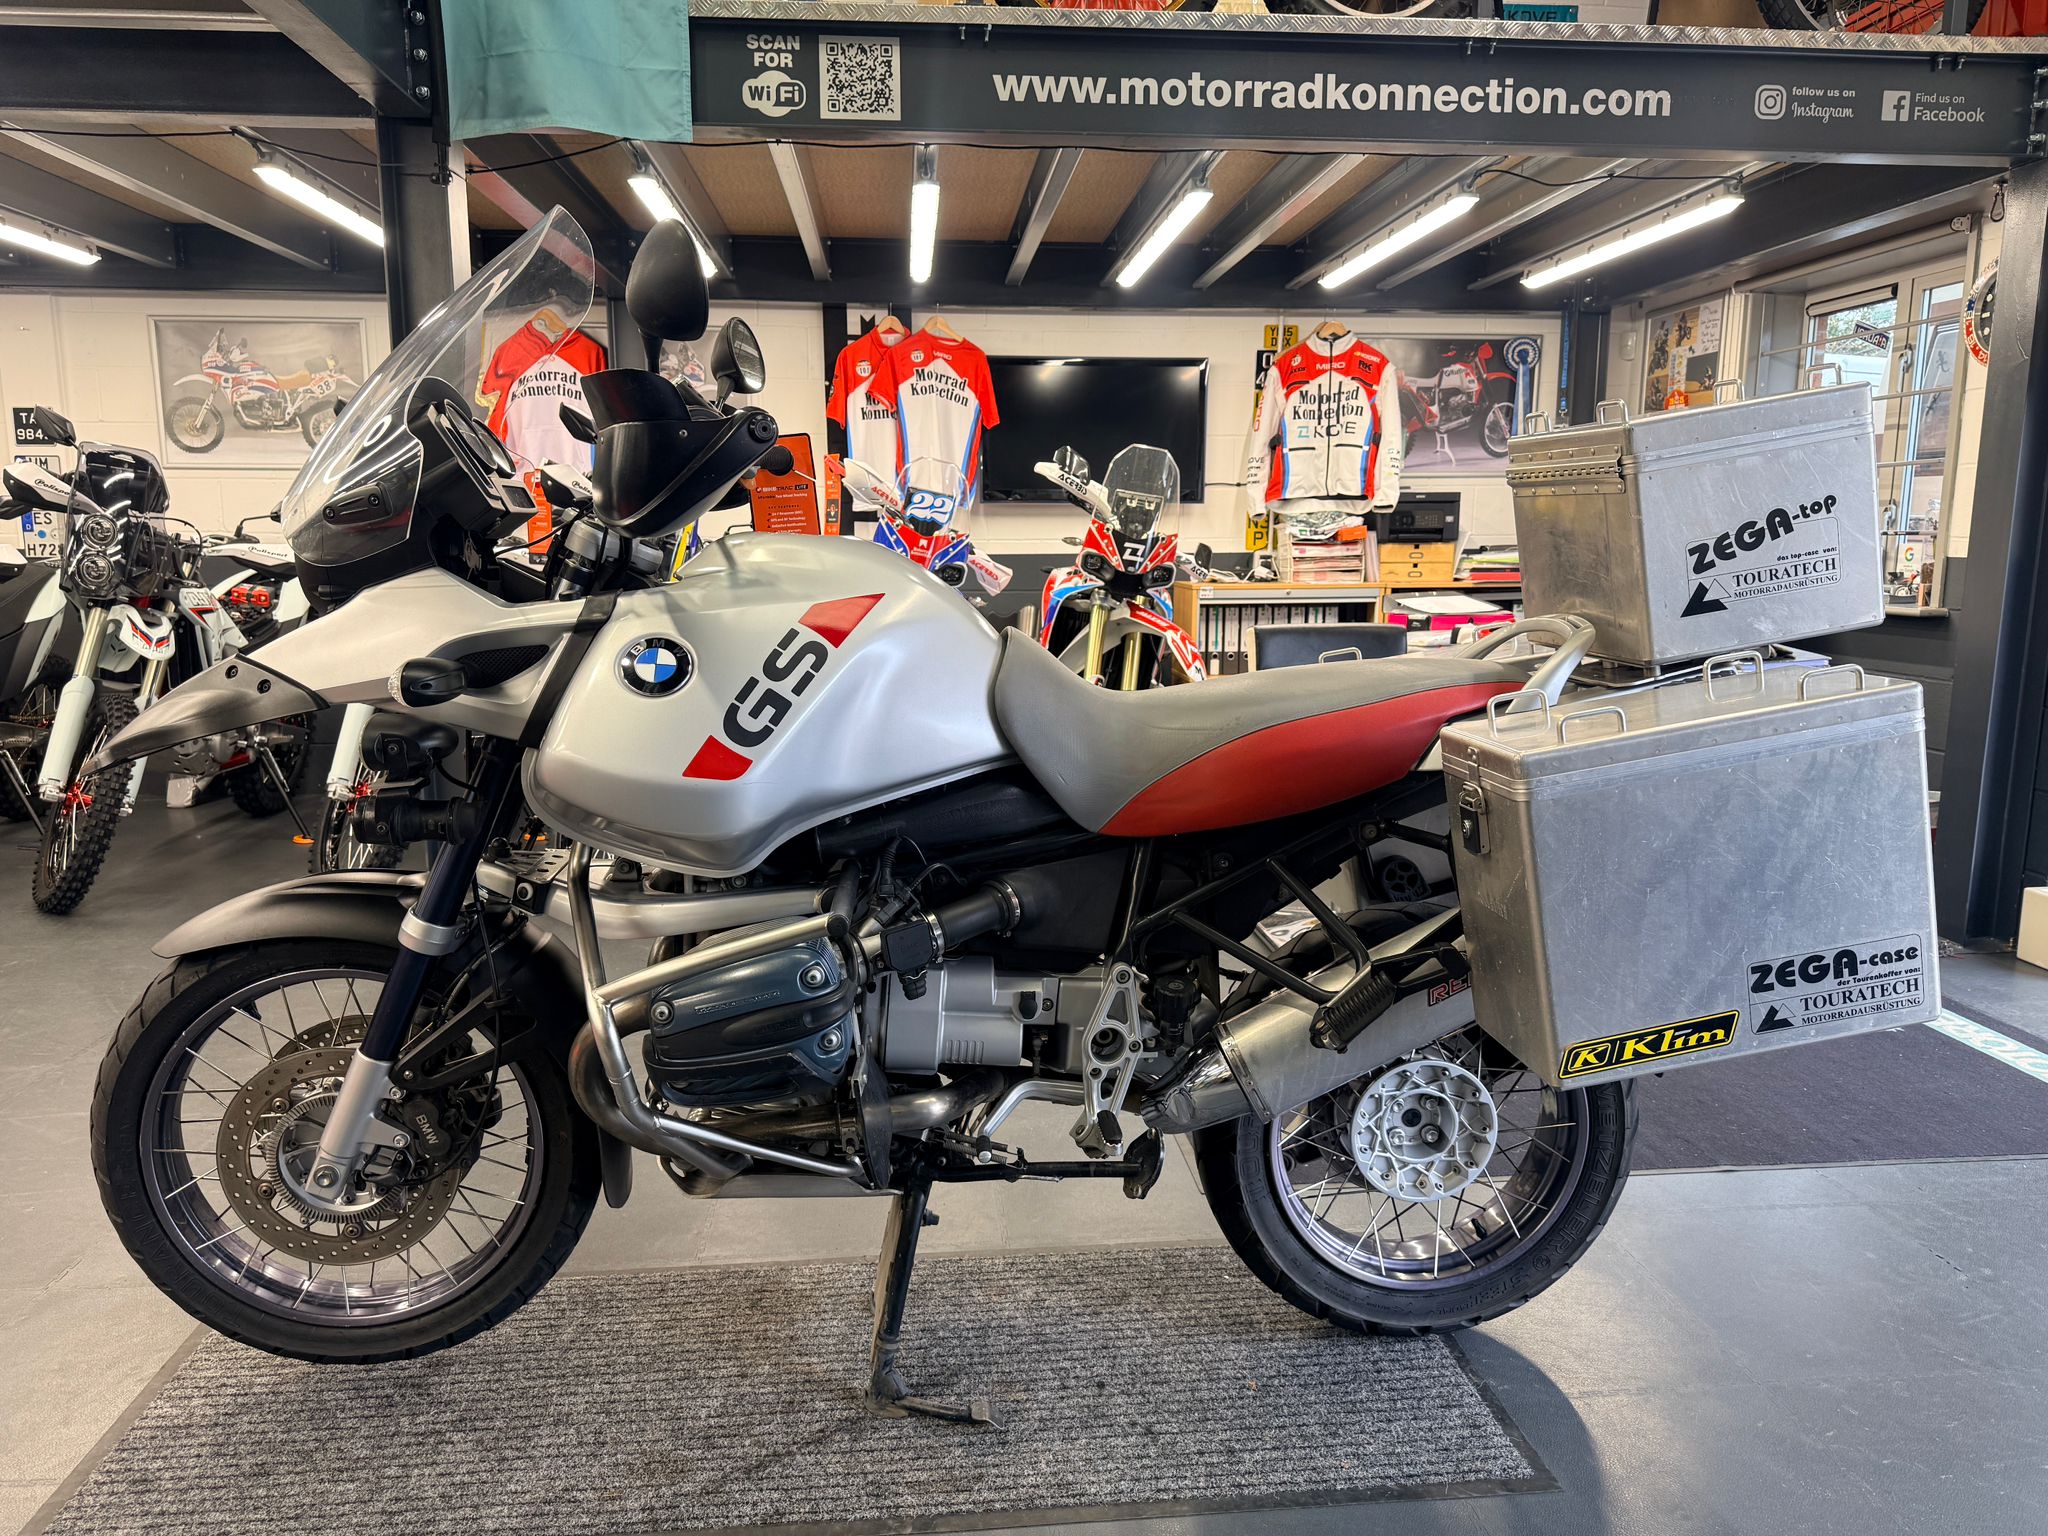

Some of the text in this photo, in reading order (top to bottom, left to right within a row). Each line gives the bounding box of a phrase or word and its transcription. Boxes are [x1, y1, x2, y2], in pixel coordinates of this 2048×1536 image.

[746, 34, 800, 50] SCAN
[753, 52, 793, 68] FOR
[992, 72, 1671, 117] www.motorradkonnection.com
[1792, 86, 1856, 98] follow us on
[1915, 92, 1965, 104] Find us on
[1791, 102, 1854, 124] Instagram
[1914, 106, 1985, 122] Facebook
[317, 380, 331, 396] 38
[34, 512, 52, 525] ES
[906, 490, 954, 524] 22
[1688, 495, 1837, 575] ZEGA-top
[1777, 554, 1789, 562] das
[1733, 557, 1837, 588] TOURATECH
[1733, 574, 1838, 599] MOTORRADAUSRÜSTUNG
[723, 628, 829, 748] GS
[1750, 946, 1918, 994] ZEGA-case
[1837, 966, 1921, 987] der Tourenkoffer von:
[1800, 977, 1920, 1012] TOURATECH
[1801, 997, 1921, 1026] MOTORRADAUSRÜSTUNG
[1574, 1047, 1608, 1070] K
[415, 1114, 439, 1144] BMW
